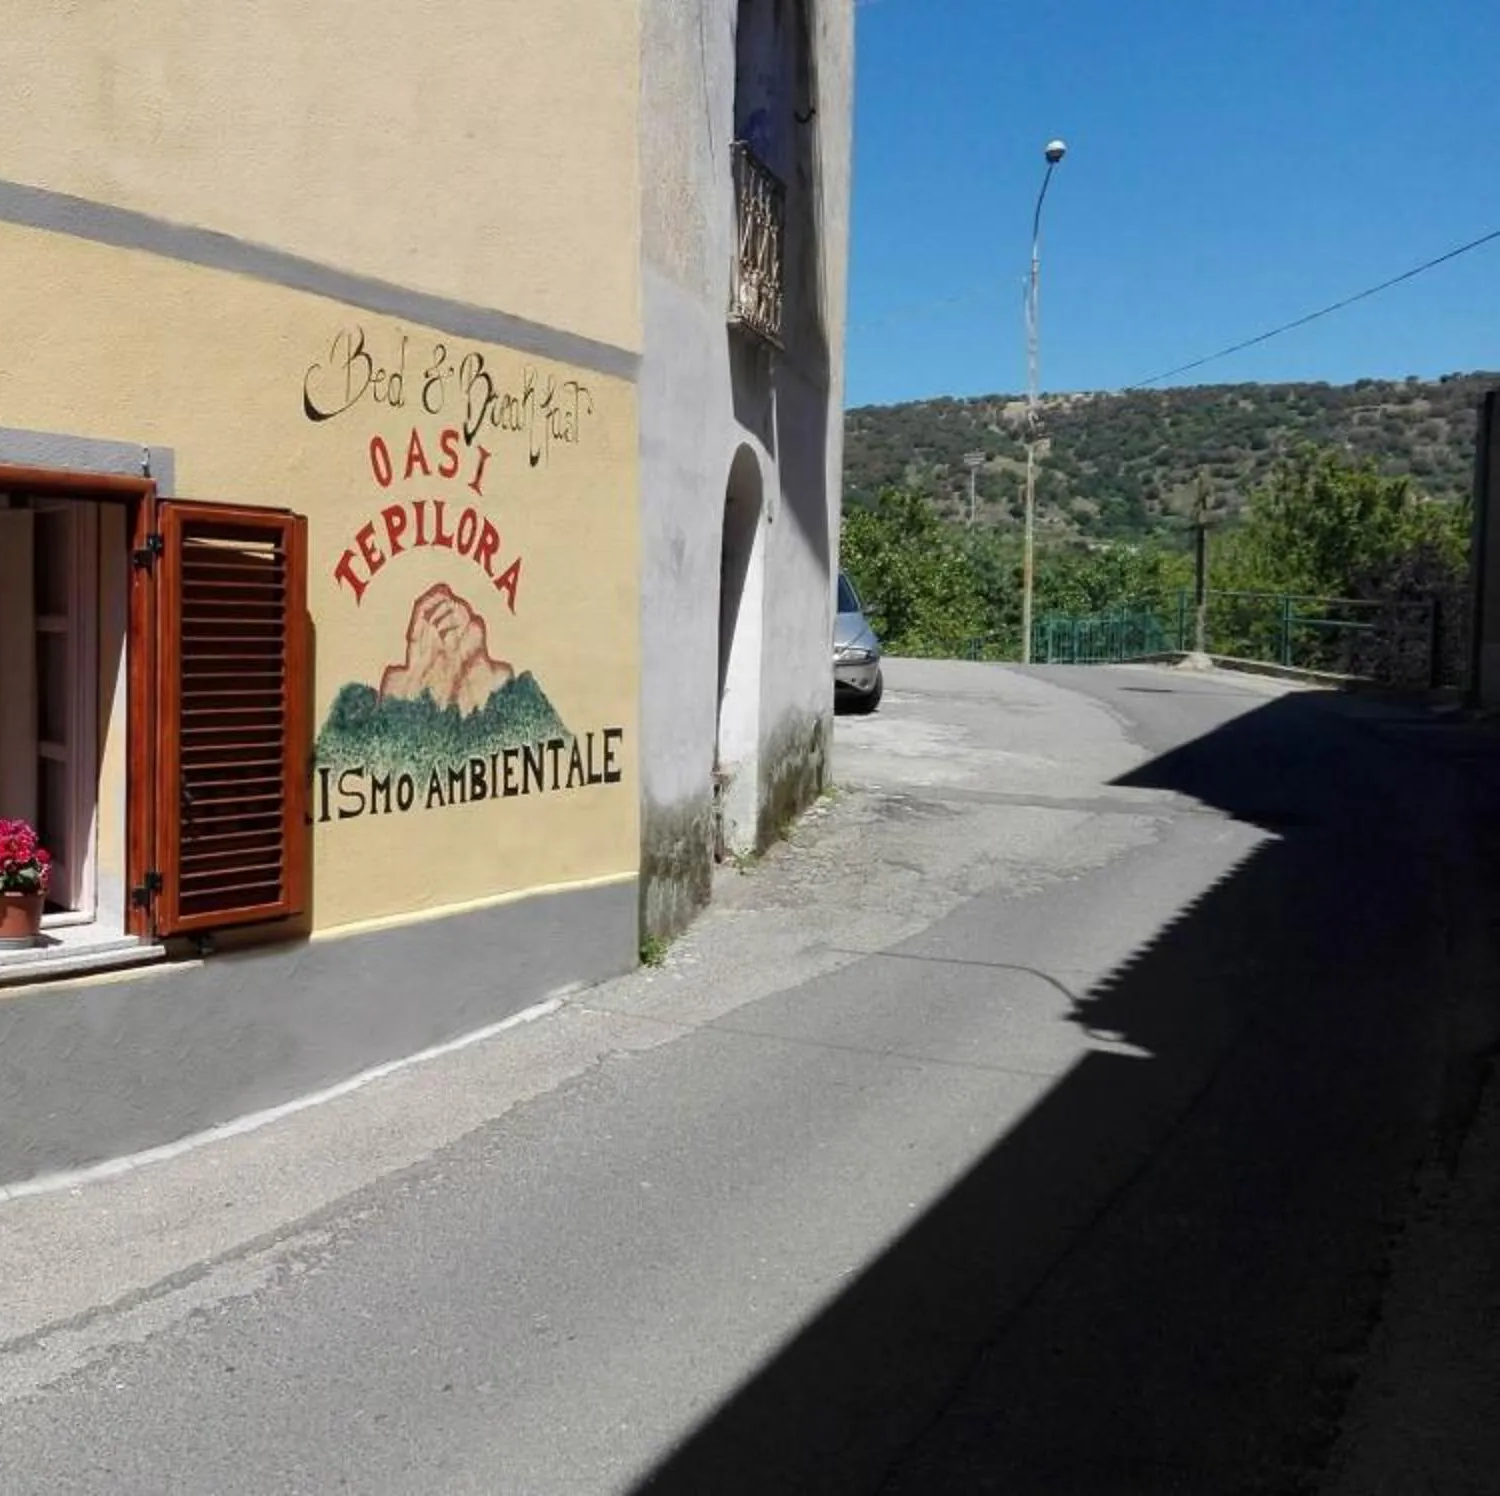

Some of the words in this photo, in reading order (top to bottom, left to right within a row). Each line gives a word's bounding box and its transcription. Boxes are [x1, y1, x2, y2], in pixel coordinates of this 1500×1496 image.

[302, 323, 407, 423] Bed
[422, 343, 455, 415] &
[459, 352, 595, 469] Breakfast
[368, 426, 492, 497] OASI
[333, 499, 523, 616] TEPILORA
[304, 766, 415, 825] ISMO
[425, 727, 624, 810] AMBIENTALE
